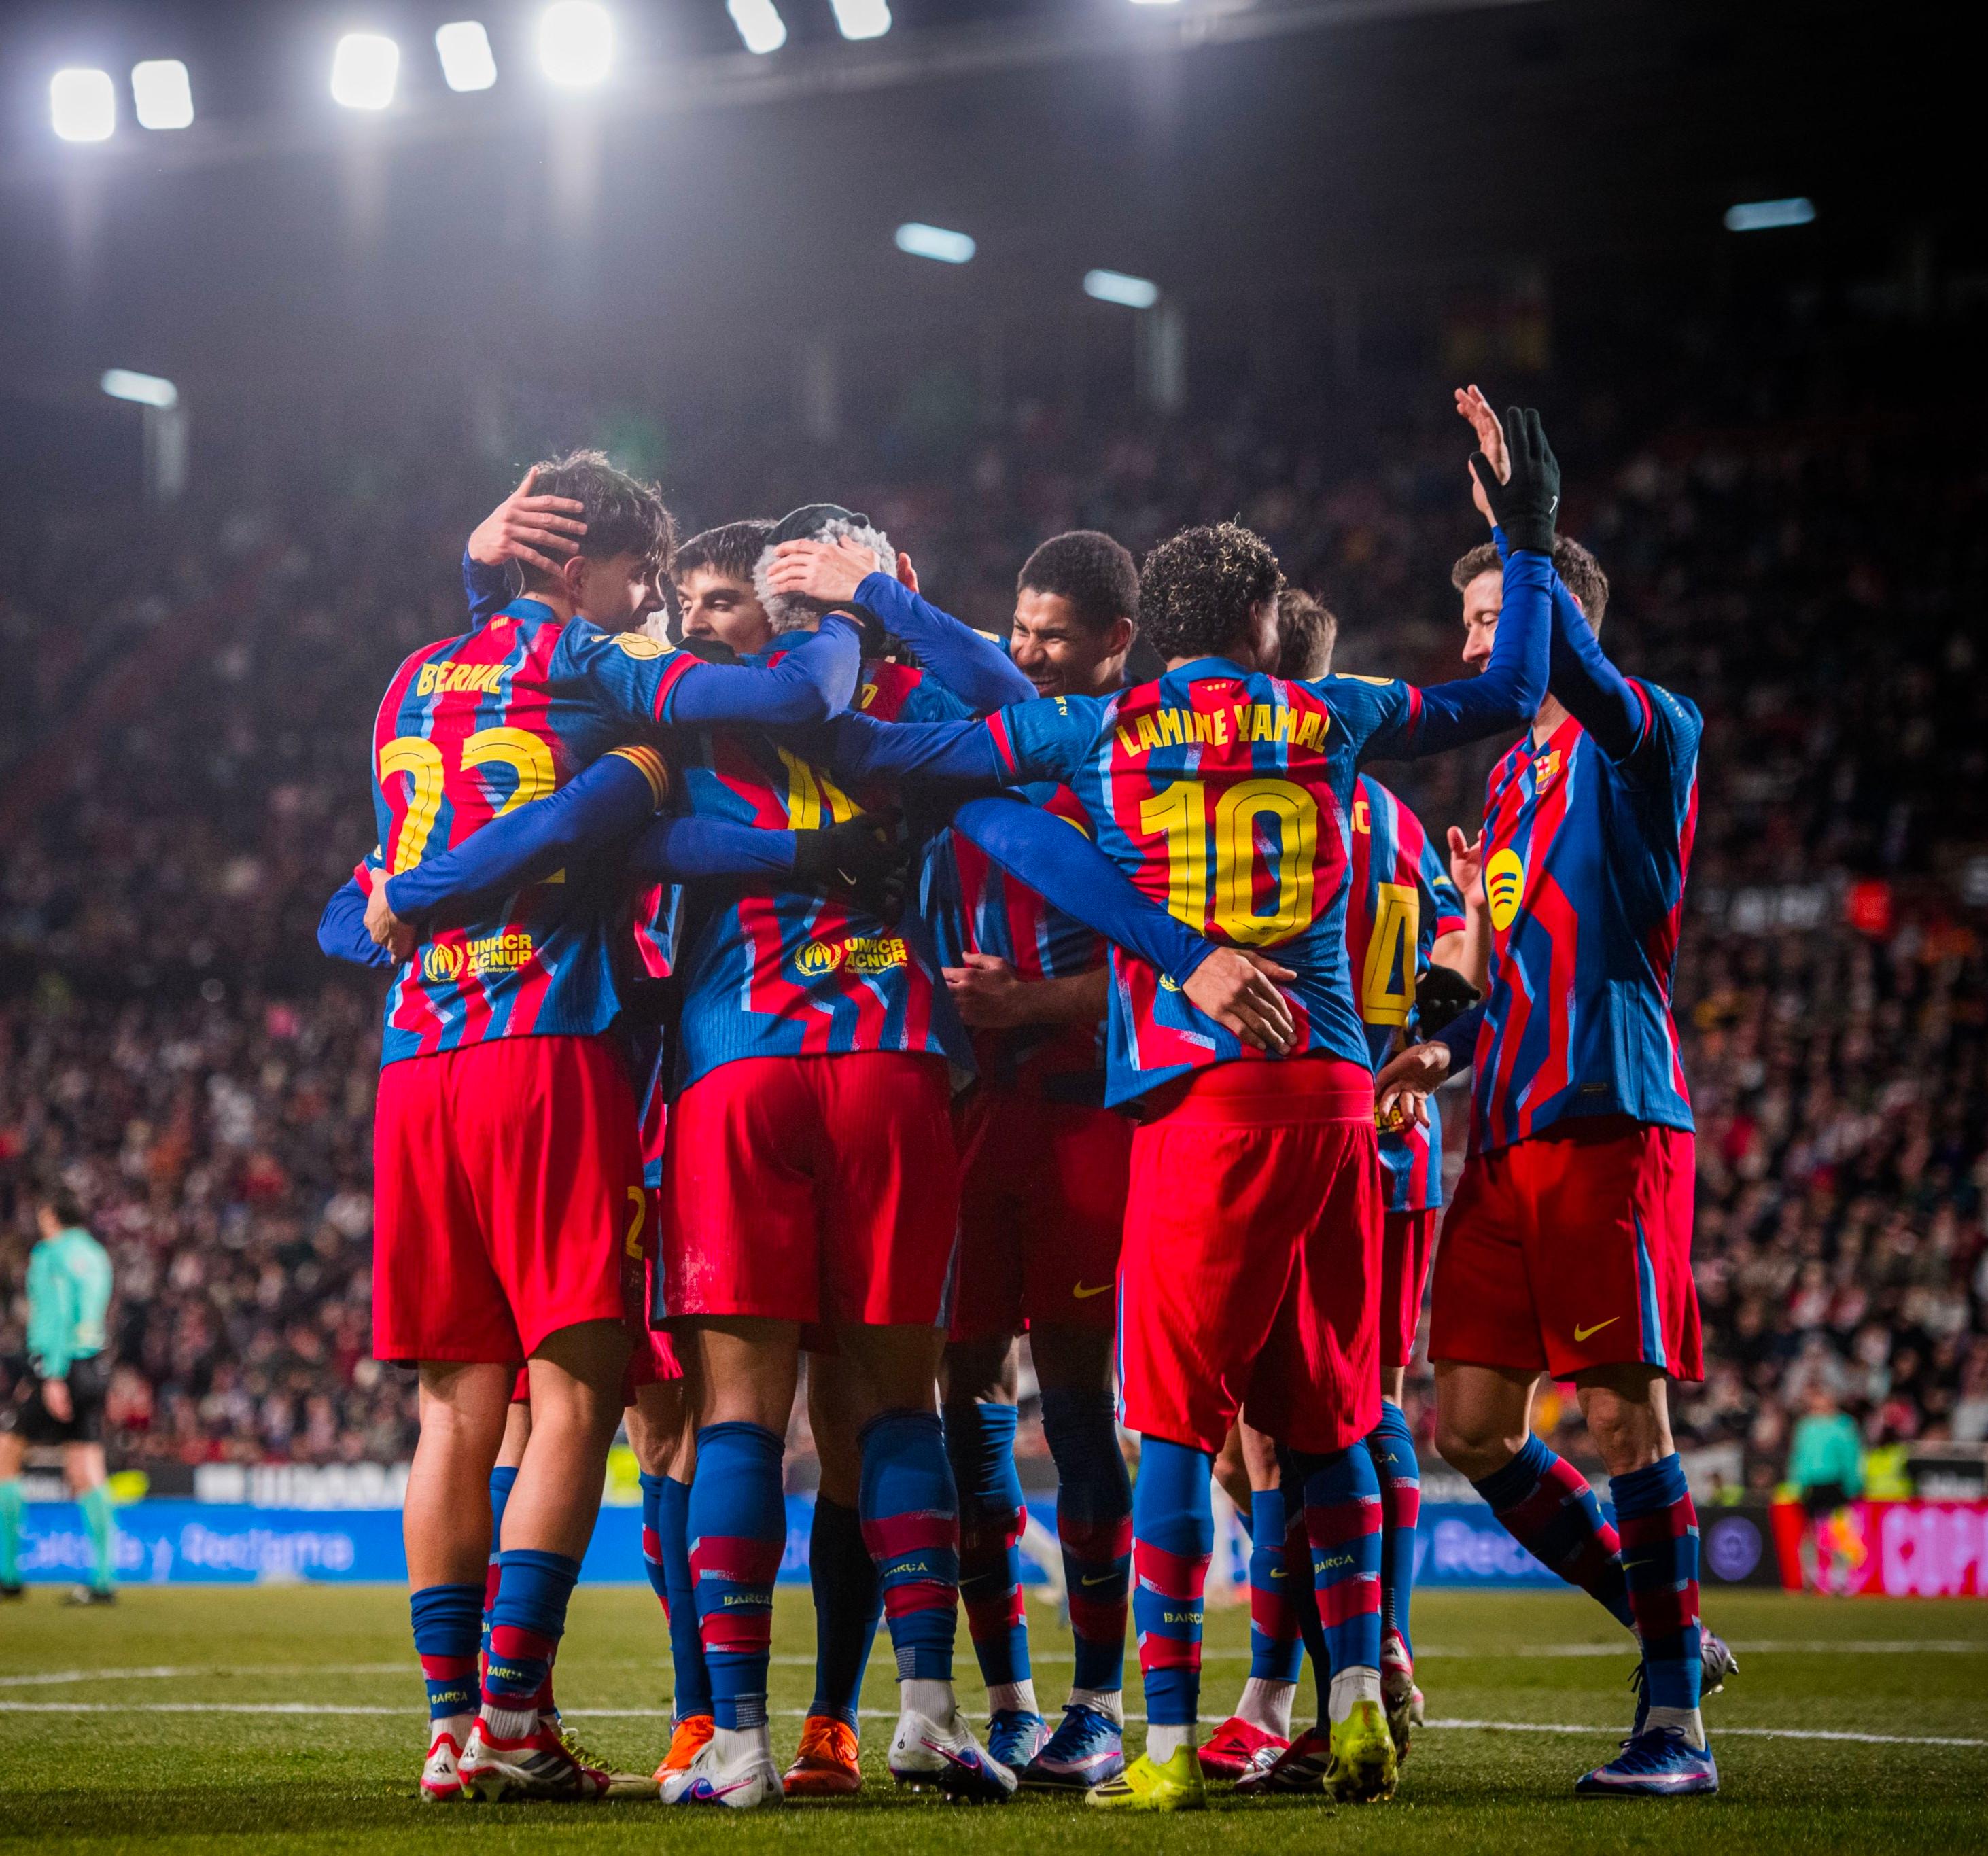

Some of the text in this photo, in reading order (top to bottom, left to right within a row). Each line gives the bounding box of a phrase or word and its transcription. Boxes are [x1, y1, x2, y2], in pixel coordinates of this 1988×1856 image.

[417, 661, 511, 696] BERNAL
[1115, 704, 1330, 758] LAMINE YAMAL
[1140, 778, 1317, 947] 10
[466, 934, 532, 956] UNHCR
[844, 937, 904, 953] UNHCR
[845, 949, 907, 968] ACNUR
[1314, 1554, 1355, 1574] BARÇA
[432, 1691, 468, 1704] BARÇA
